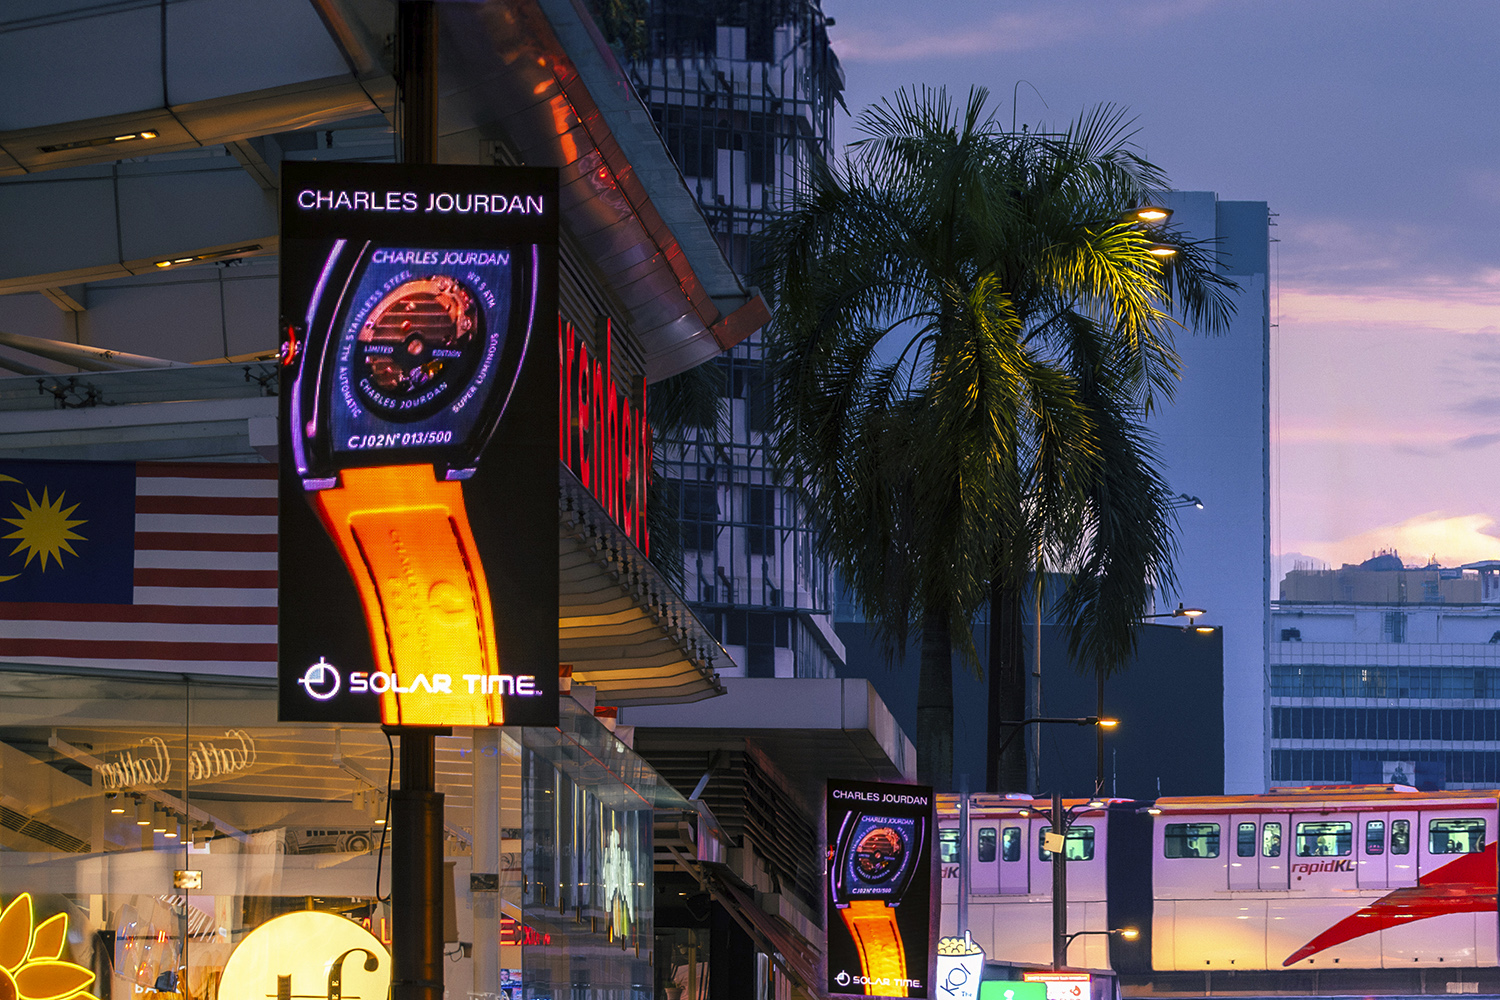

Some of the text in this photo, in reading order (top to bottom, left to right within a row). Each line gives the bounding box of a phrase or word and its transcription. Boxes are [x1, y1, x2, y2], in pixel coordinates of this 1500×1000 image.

[298, 190, 544, 214] CHARLES JOURDAN
[371, 250, 510, 266] CHARLES JOURDAN
[383, 269, 413, 292] STEEL
[345, 289, 384, 341] STAINLESS
[364, 345, 462, 358] LIMITED EDITION
[451, 332, 500, 414] SUPER LUMINOUS
[338, 365, 363, 419] AUTOMATIC
[359, 378, 448, 410] CHARLES JOURDAN
[557, 308, 649, 560] renheit
[350, 672, 451, 694] SOLAR
[833, 790, 928, 805] CHARLES JOURDAN
[1292, 859, 1356, 875] rapidKL
[853, 976, 890, 985] SOLAR
[940, 963, 971, 996] KOI
